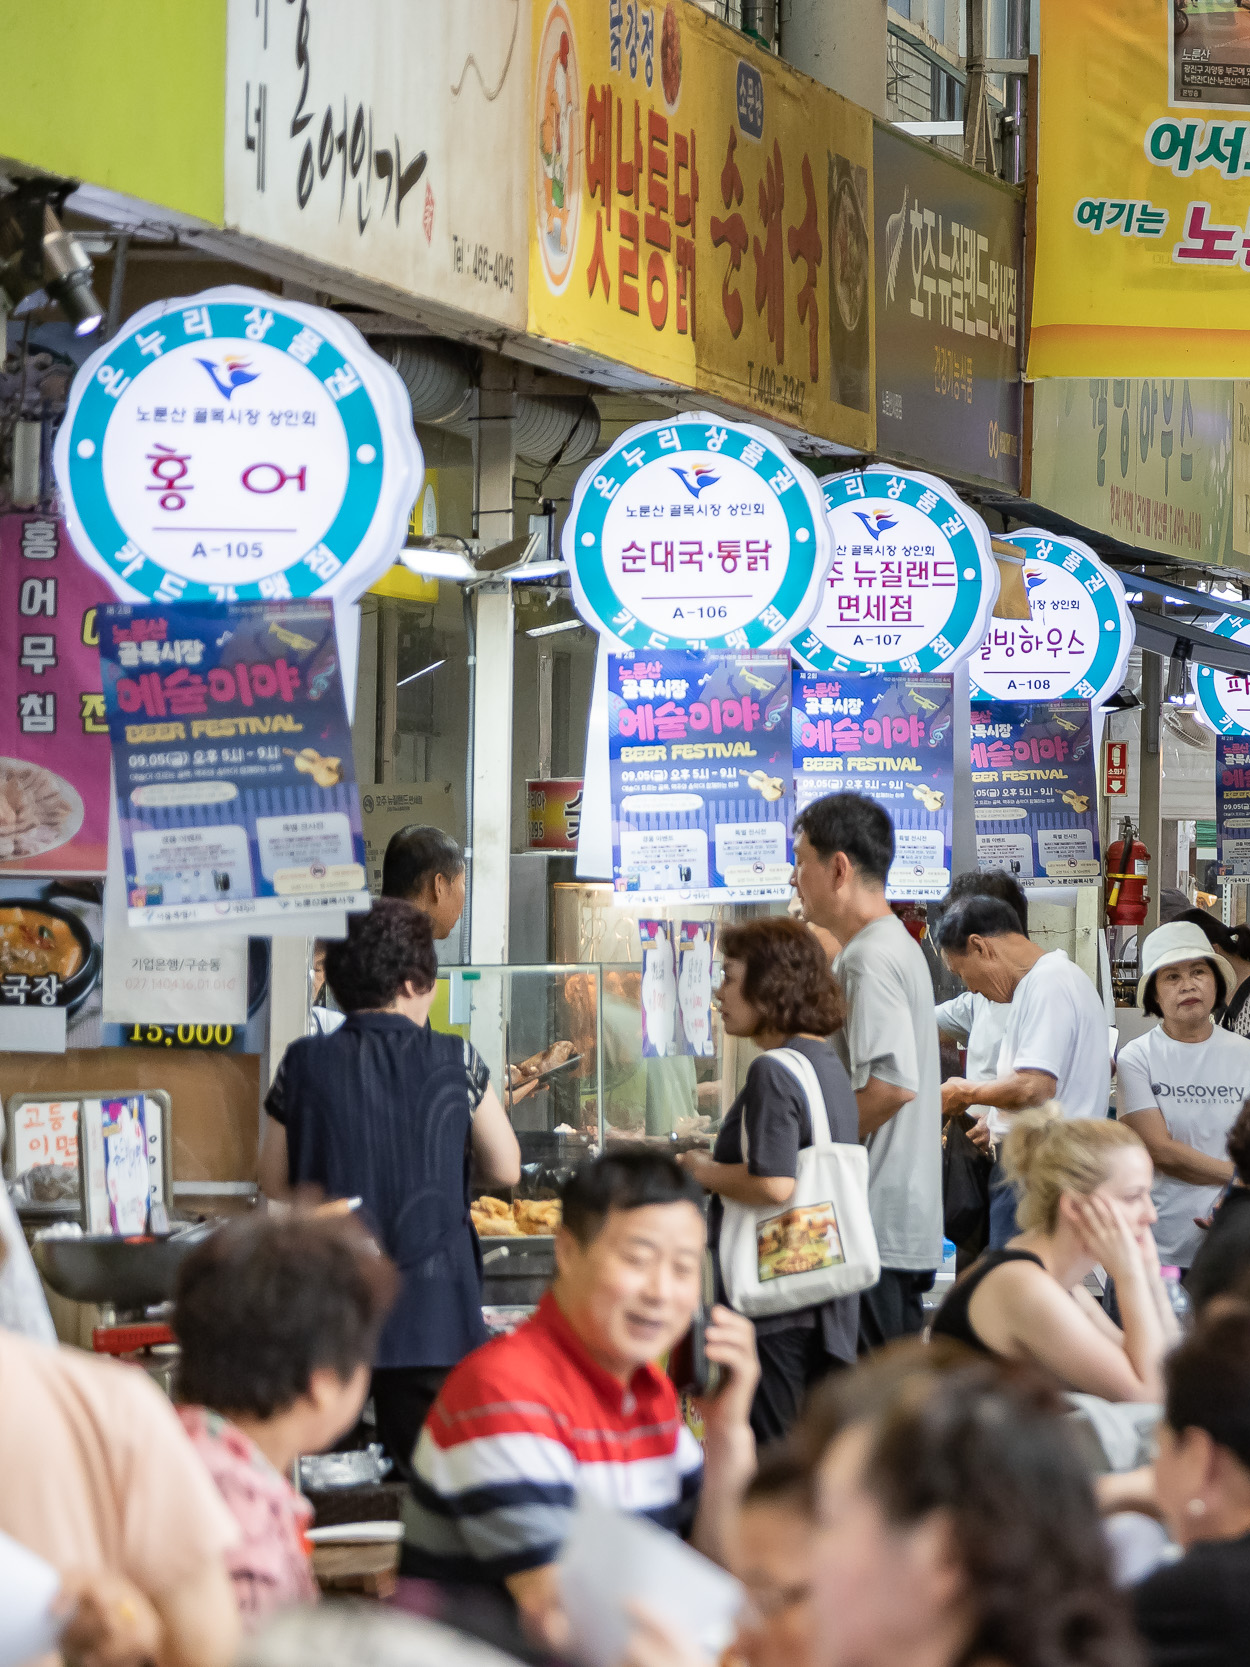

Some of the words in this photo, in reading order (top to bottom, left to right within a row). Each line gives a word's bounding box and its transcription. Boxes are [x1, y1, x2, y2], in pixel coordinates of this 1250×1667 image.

[1182, 48, 1211, 61] 노룬산
[585, 83, 700, 343] 옛날통닭
[1077, 200, 1166, 235] 여기는
[98, 305, 362, 401] 온누리상품권
[136, 407, 187, 423] 노룬산
[193, 407, 260, 424] 골목시장
[268, 410, 317, 427] 상인회
[594, 425, 796, 501] 온누리상품권
[626, 504, 665, 518] 노룬산
[670, 504, 721, 517] 골목시장
[727, 503, 766, 516] 상인회
[191, 541, 263, 559] A-105
[621, 539, 773, 573] 순대국·통닭
[851, 545, 897, 557] 골목시장
[902, 545, 936, 557] 상인회
[853, 559, 957, 588] 뉴질랜드
[672, 606, 728, 620] A-106
[838, 594, 913, 623] 면세점
[1050, 599, 1081, 611] 상인회
[853, 634, 902, 646] A-107
[619, 661, 663, 681] 노룬산
[622, 678, 690, 700] 골목시장
[802, 681, 842, 699] 노룬산
[1007, 680, 1051, 690] A-108
[805, 697, 864, 716] 골목시장
[191, 714, 304, 739] FESTIVAL
[618, 695, 761, 741] 예술이야
[801, 714, 926, 753] 예술이야
[620, 744, 668, 763] BEER
[671, 741, 758, 761] FESTIVAL
[802, 757, 844, 772] BEER
[847, 757, 923, 772] FESTIVAL
[971, 771, 999, 783] EER
[1002, 768, 1069, 782] FESTIVAL
[1159, 1081, 1245, 1102] Discovery
